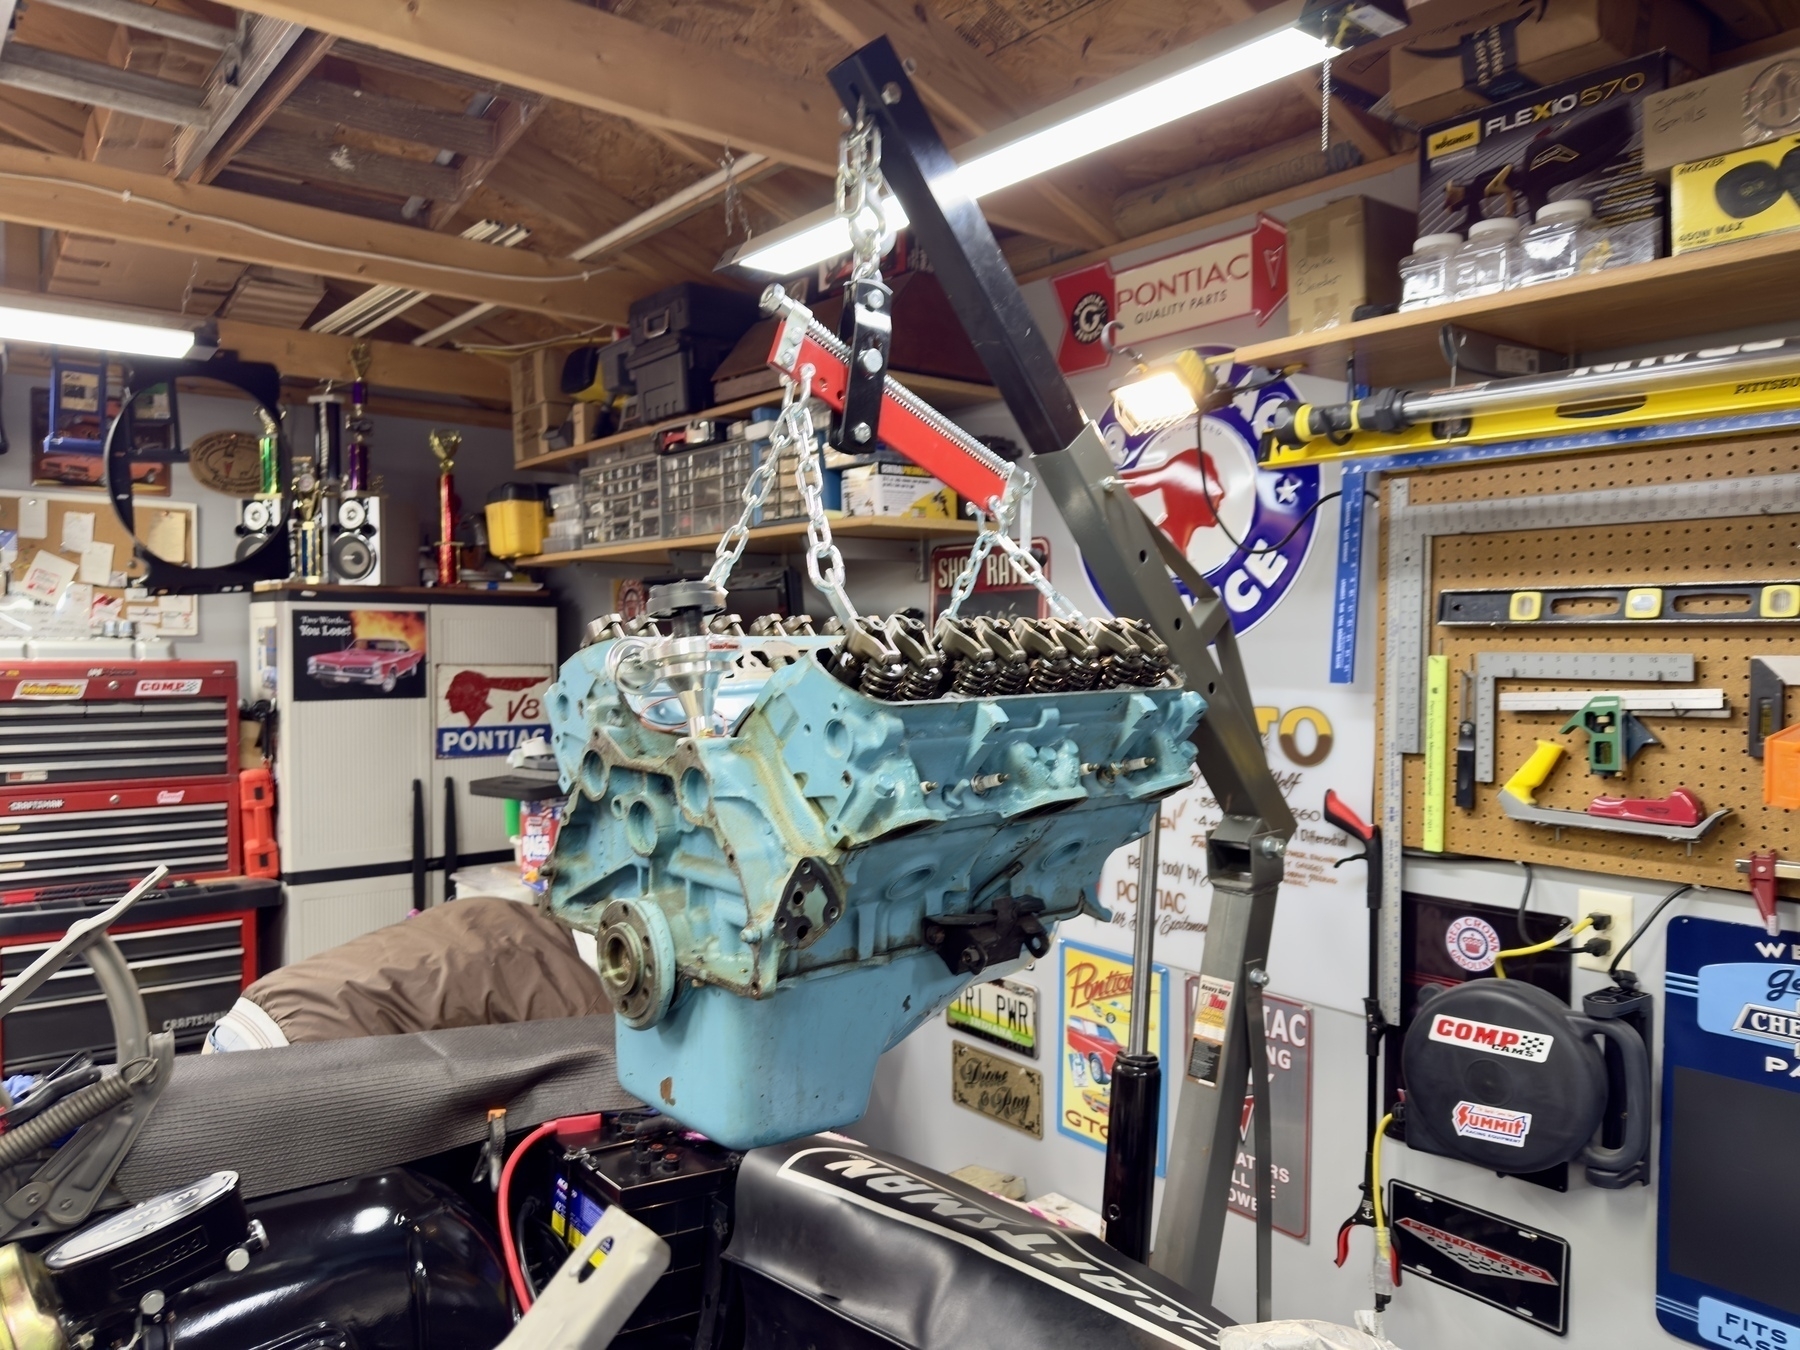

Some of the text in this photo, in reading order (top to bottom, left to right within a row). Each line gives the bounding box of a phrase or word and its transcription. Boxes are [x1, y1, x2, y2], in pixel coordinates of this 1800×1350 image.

[1579, 72, 1645, 107] 570
[1116, 253, 1250, 313] PONTIAC
[1134, 288, 1228, 326] QUALITY PARTS
[938, 552, 1034, 589] SHO RATE
[299, 624, 352, 637] You Lose!
[140, 682, 185, 692] COMP
[507, 693, 540, 723] V8
[1116, 879, 1187, 915] POIAC
[1160, 914, 1208, 938] Excitemen
[1448, 917, 1498, 952] RED CROWN
[1201, 983, 1219, 994] Heavy
[1218, 987, 1231, 997] Duty
[1209, 993, 1227, 1011] Ton
[996, 994, 1028, 1035] PWR
[1436, 1018, 1520, 1048] COMP
[1491, 1042, 1536, 1058] CAMS
[1465, 1129, 1521, 1144] RACING EQUIPMENT
[1409, 1220, 1543, 1278] PONTIAC GTO
[1469, 1251, 1525, 1277] LITRE
[1726, 1312, 1788, 1344] FITS
